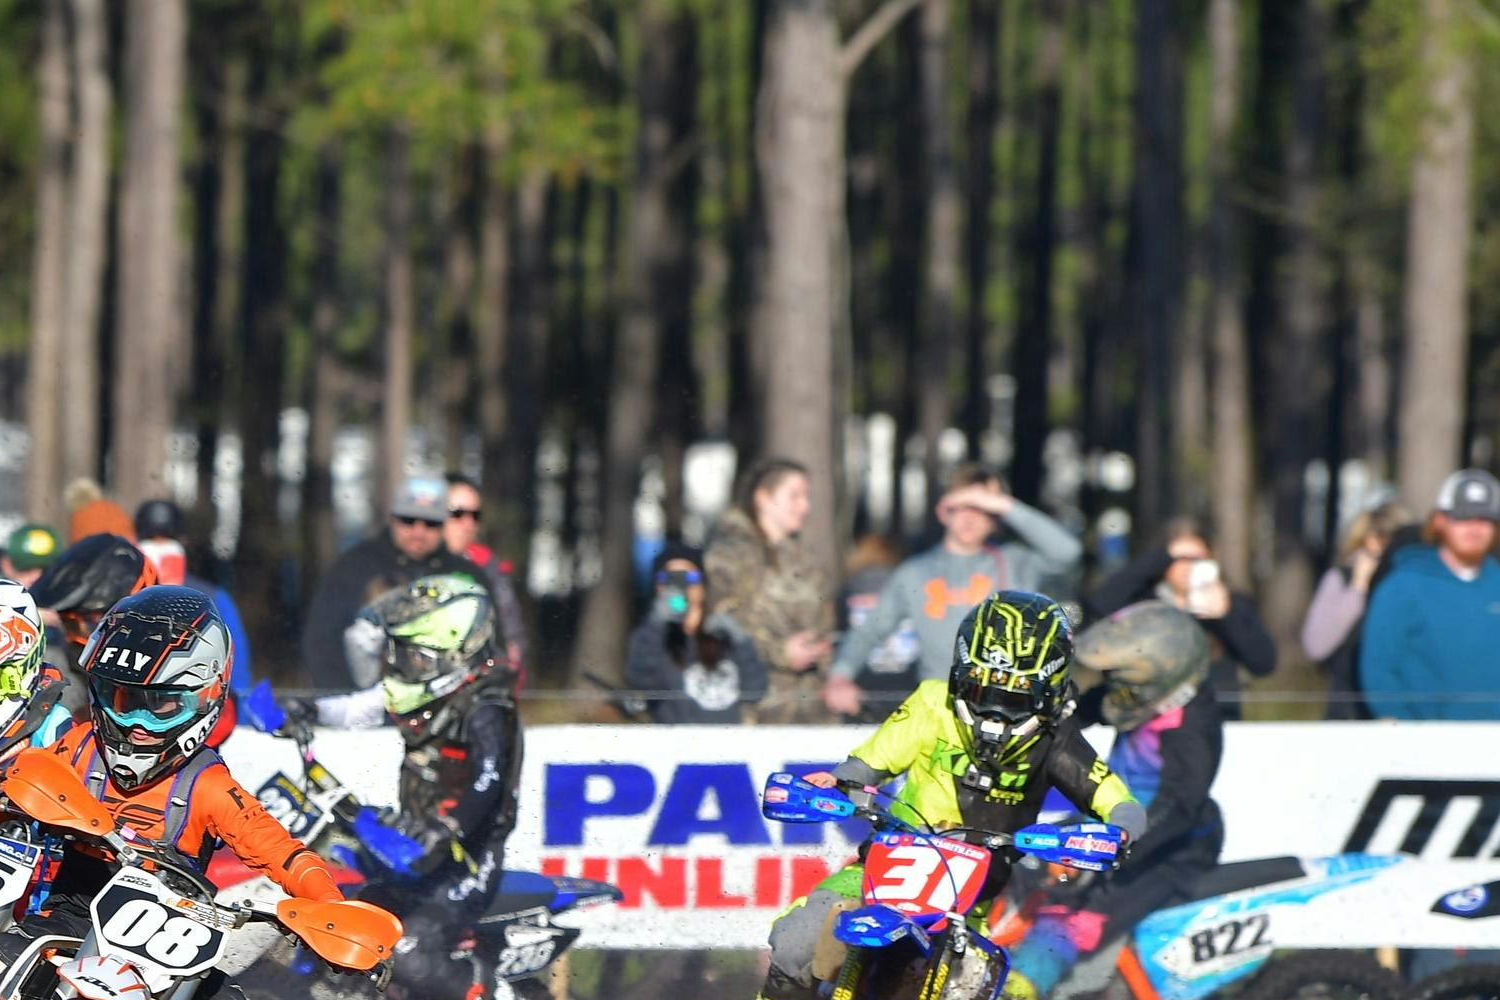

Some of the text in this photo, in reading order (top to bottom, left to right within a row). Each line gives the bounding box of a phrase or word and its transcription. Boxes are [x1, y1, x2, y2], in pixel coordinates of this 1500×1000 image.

[100, 647, 152, 672] FLY
[864, 846, 979, 912] 31
[101, 899, 212, 968] 08
[1189, 913, 1272, 964] 822
[75, 975, 118, 997] KTM
